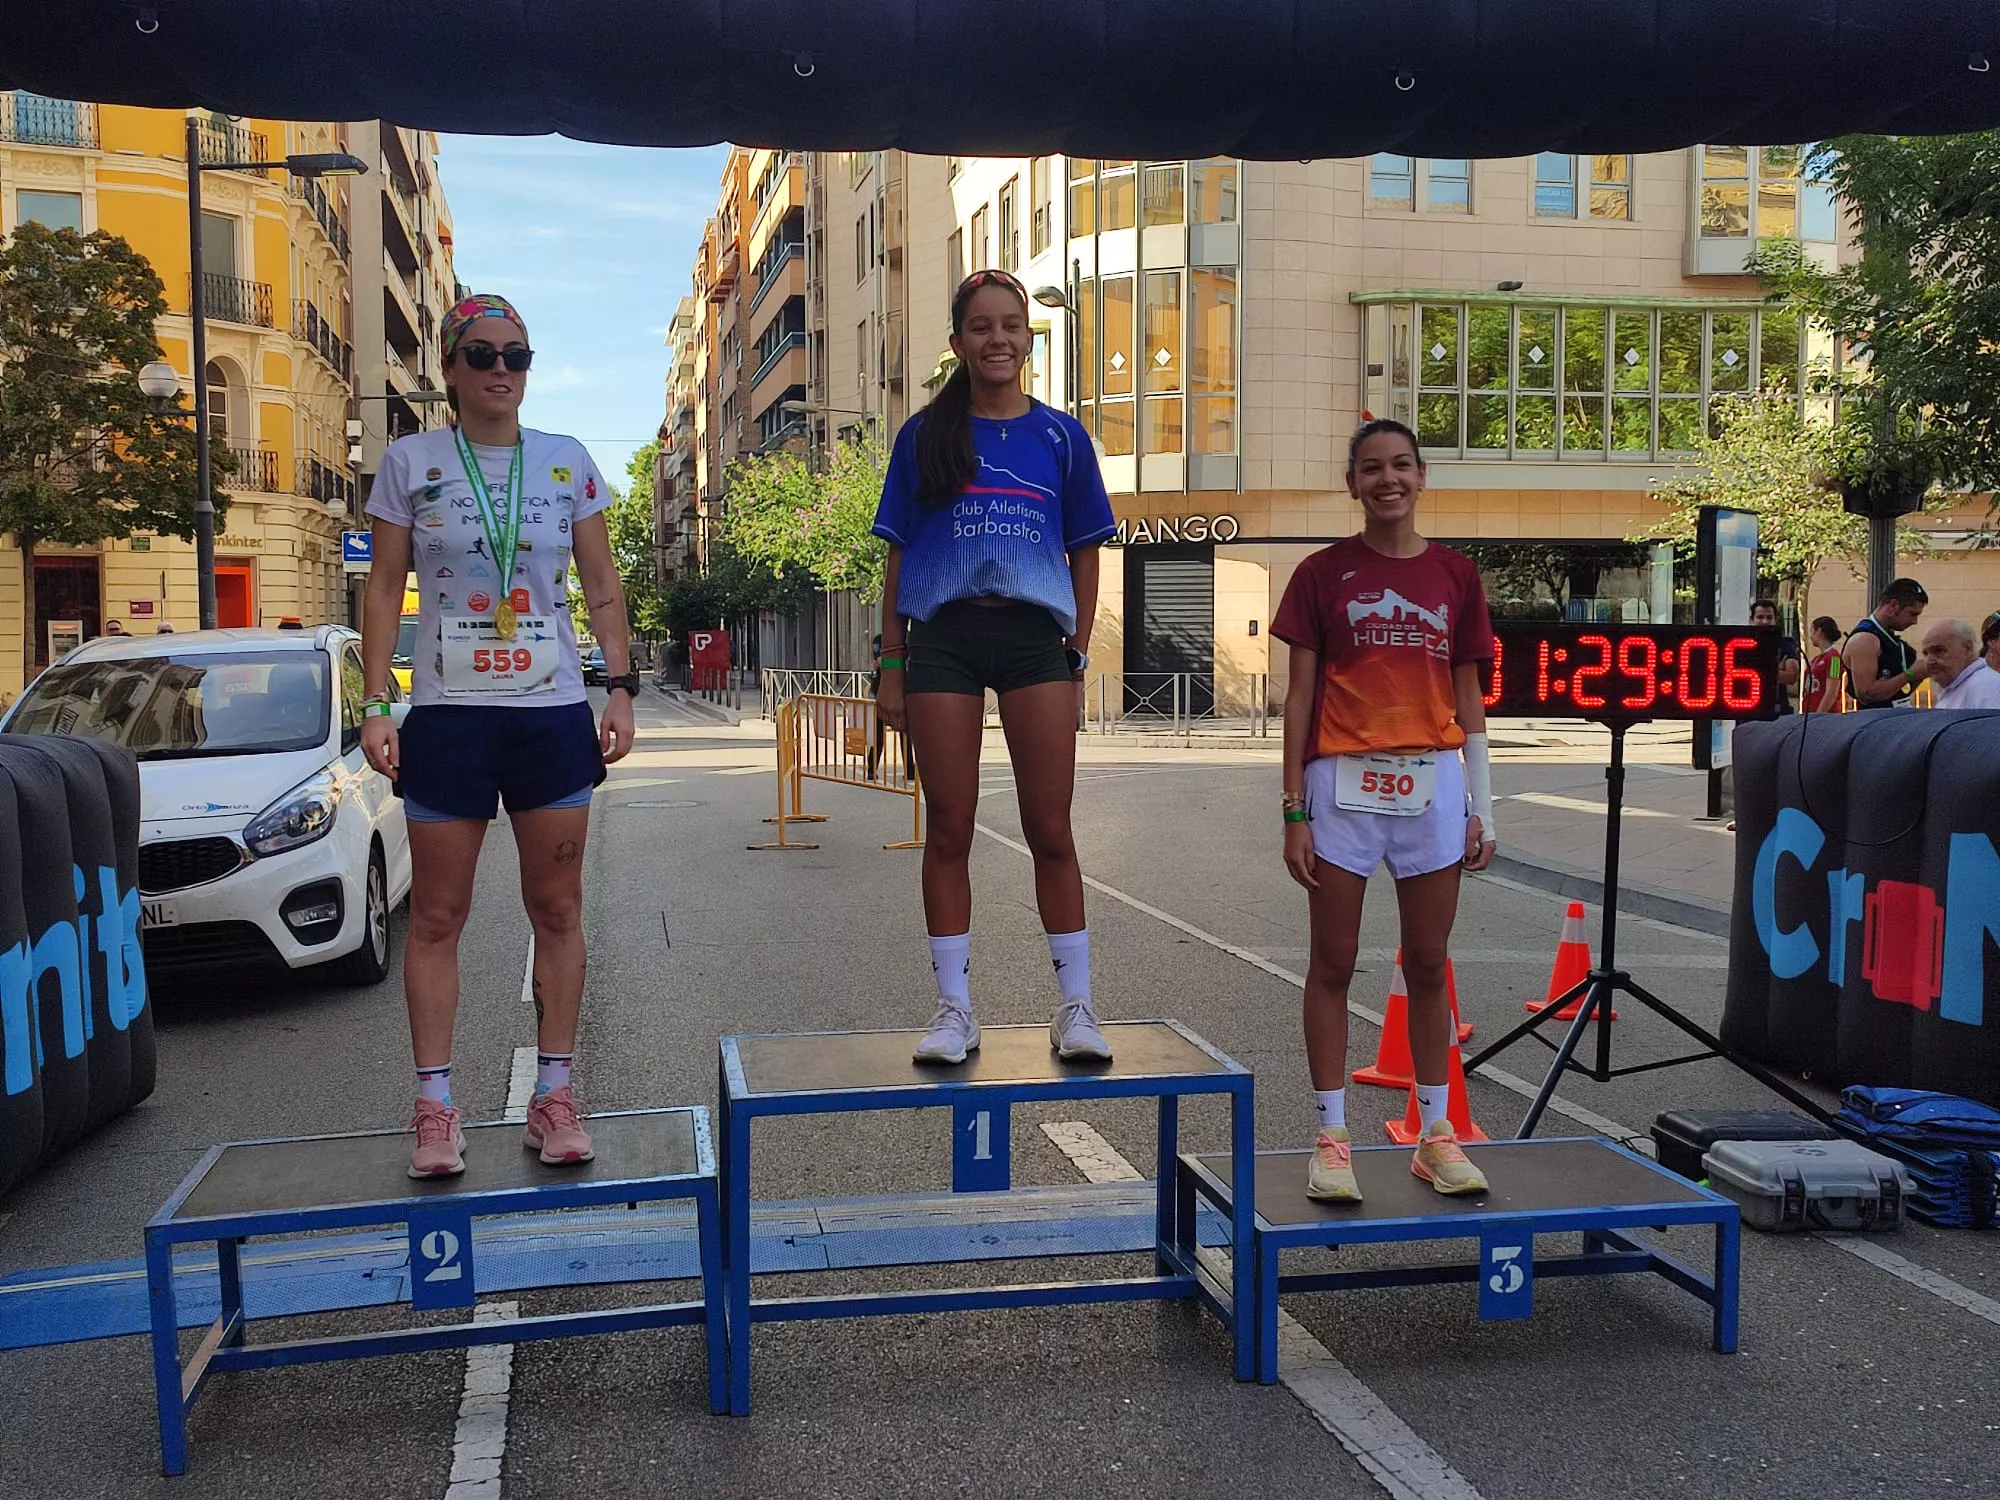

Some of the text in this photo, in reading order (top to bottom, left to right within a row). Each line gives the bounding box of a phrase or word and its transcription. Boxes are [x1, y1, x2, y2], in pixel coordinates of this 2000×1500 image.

[451, 496, 475, 509] NO
[952, 499, 1046, 524] Club Atletismo
[953, 513, 1041, 544] Barbastro
[1353, 629, 1450, 654] HUESCA
[472, 647, 533, 673] 559
[1360, 770, 1415, 797] 530
[967, 1110, 993, 1160] 1
[421, 1230, 462, 1283] 2
[1489, 1246, 1524, 1293] 3
